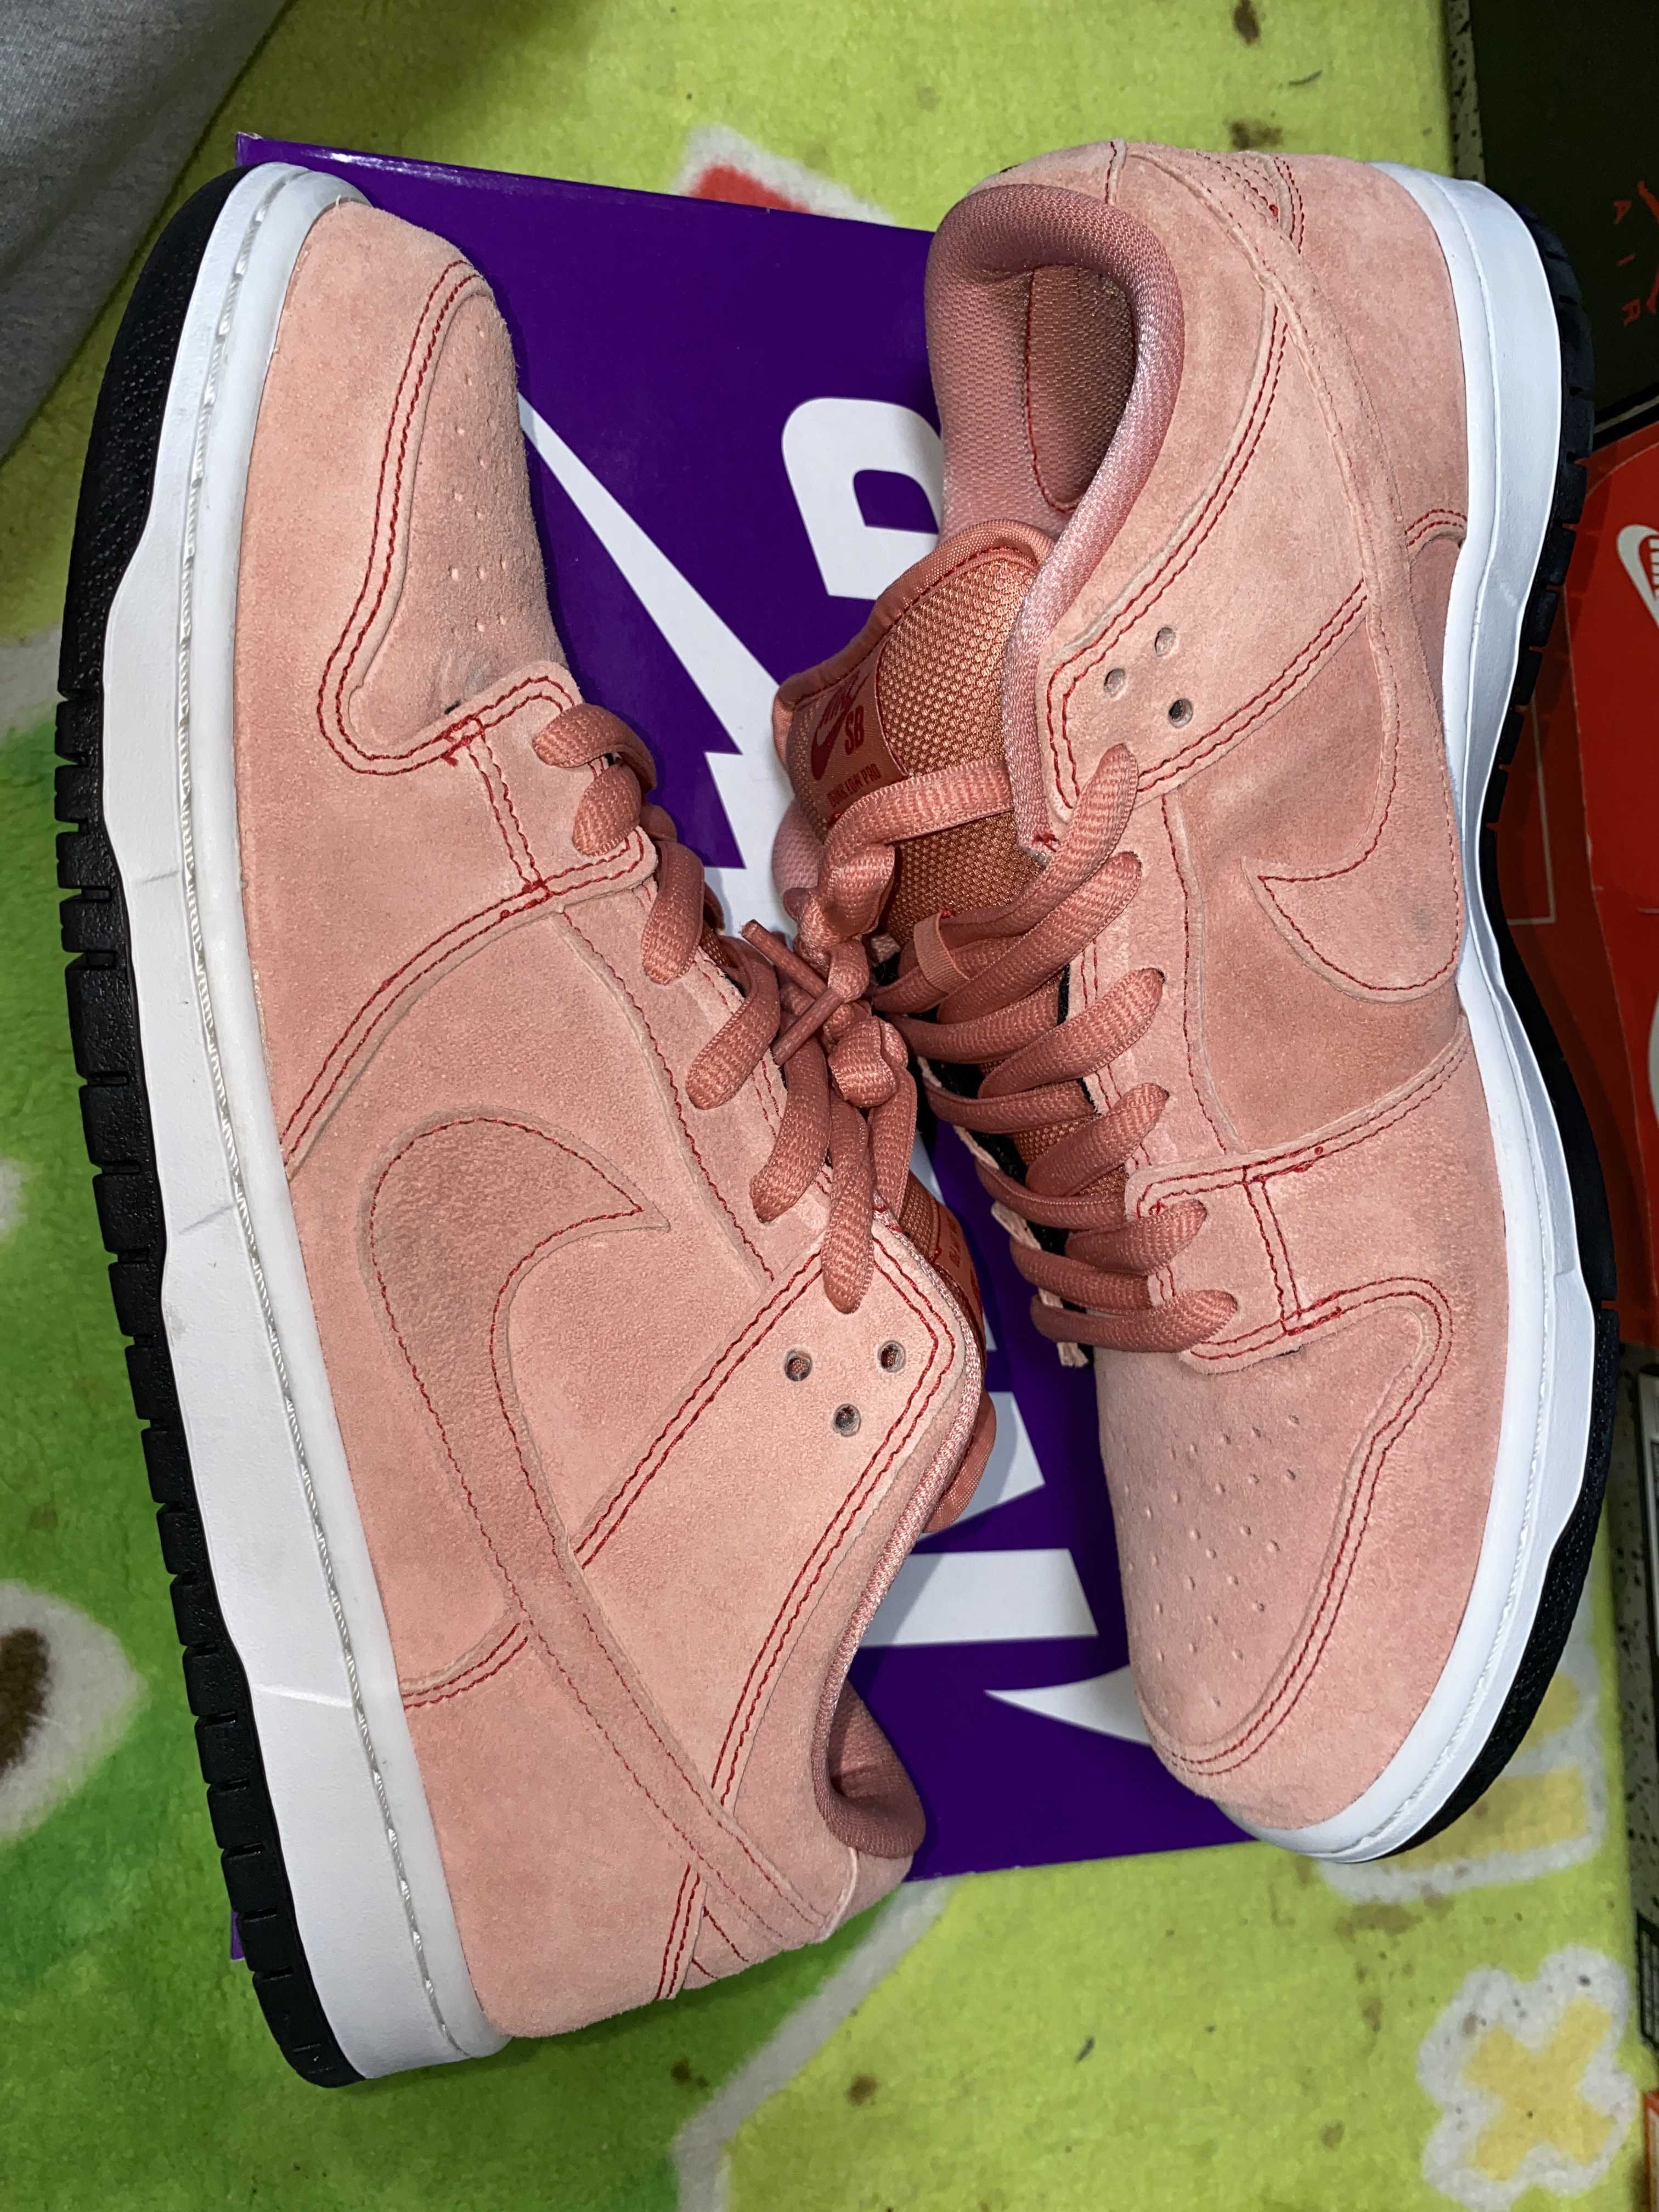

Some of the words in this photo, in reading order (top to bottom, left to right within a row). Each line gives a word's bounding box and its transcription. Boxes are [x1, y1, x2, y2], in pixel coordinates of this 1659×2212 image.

[845, 706, 864, 755] SB
[827, 780, 848, 807] DUNK
[845, 769, 864, 794] LOW
[861, 763, 882, 787] PRO
